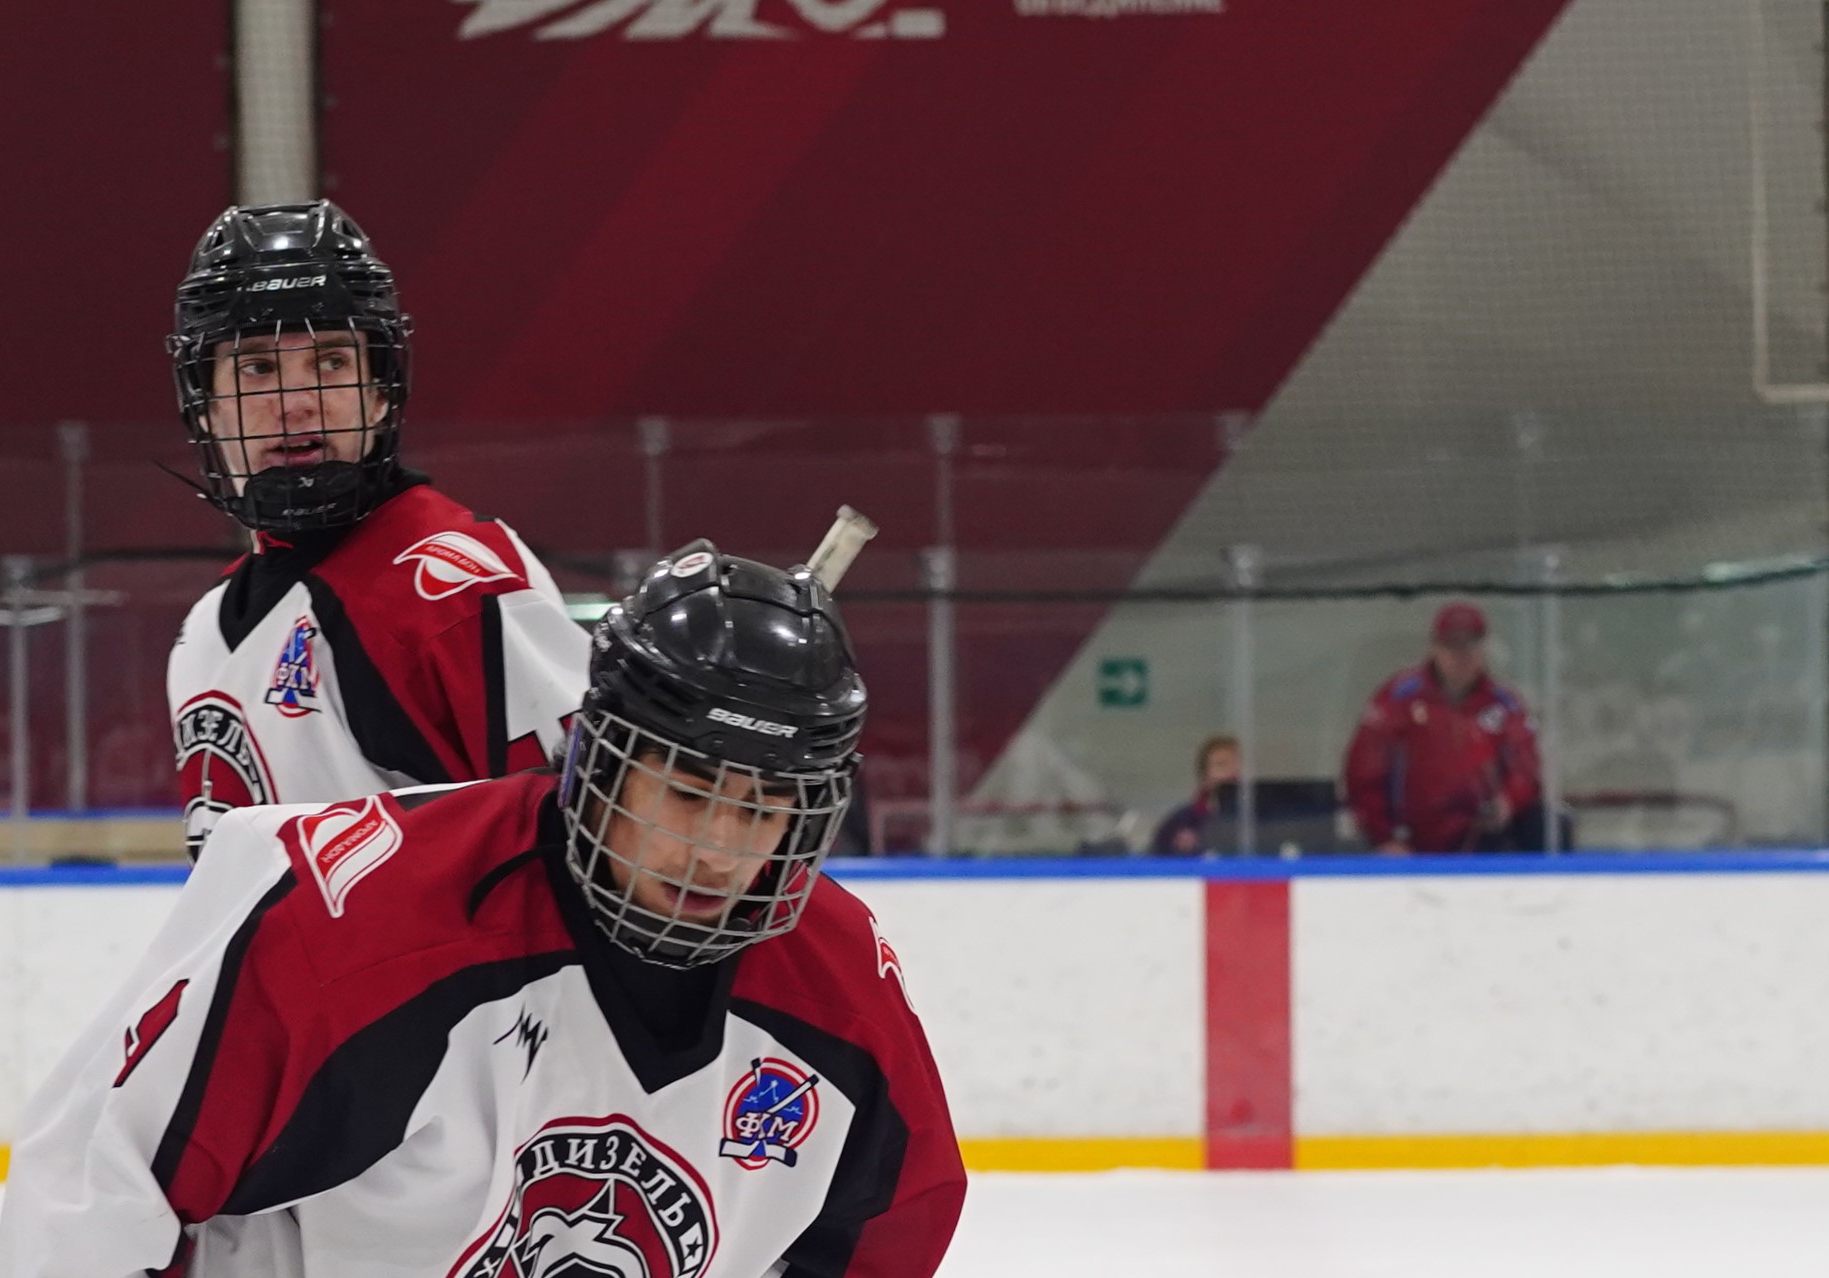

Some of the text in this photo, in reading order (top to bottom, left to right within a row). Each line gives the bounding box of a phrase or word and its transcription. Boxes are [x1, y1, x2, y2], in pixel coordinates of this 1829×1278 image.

[251, 274, 328, 292] BAUER
[706, 707, 800, 739] BAUER
[531, 1135, 693, 1227] ДИЗЕЛЬ
